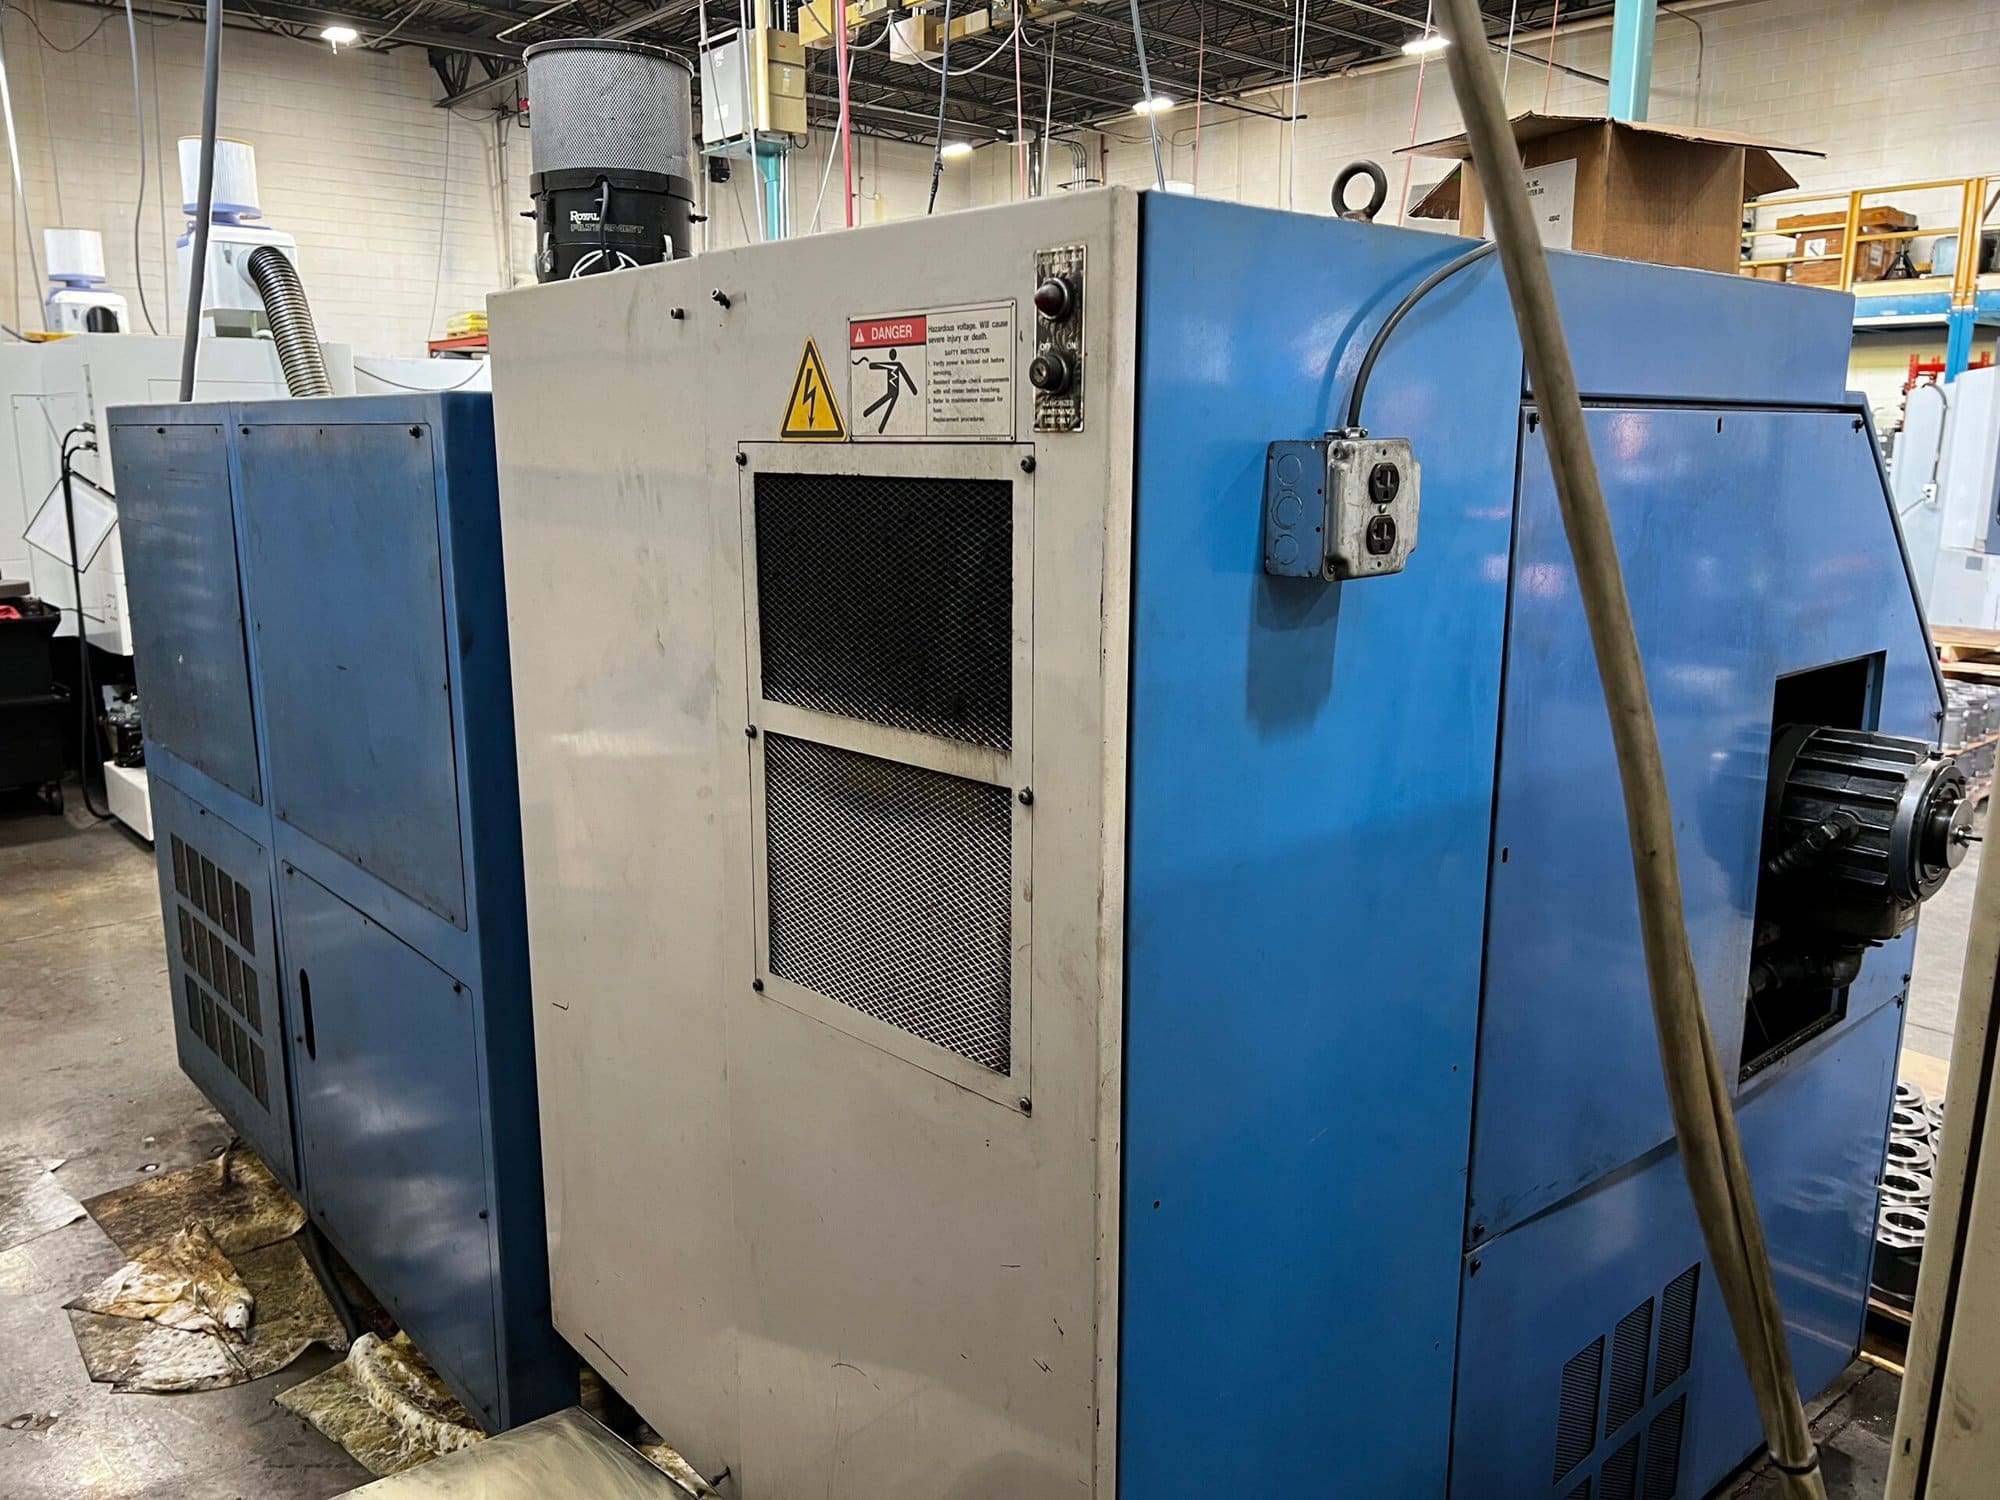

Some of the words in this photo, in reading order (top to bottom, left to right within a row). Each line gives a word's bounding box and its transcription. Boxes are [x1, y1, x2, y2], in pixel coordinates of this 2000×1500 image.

[871, 324, 913, 340] DANGER
[928, 324, 955, 333] Hazardous
[956, 322, 977, 331] voltage.
[979, 320, 990, 329] Will
[991, 320, 1009, 328] cause
[928, 336, 945, 344] severe
[971, 332, 988, 341] death.
[960, 347, 990, 355] INSTRUCTION
